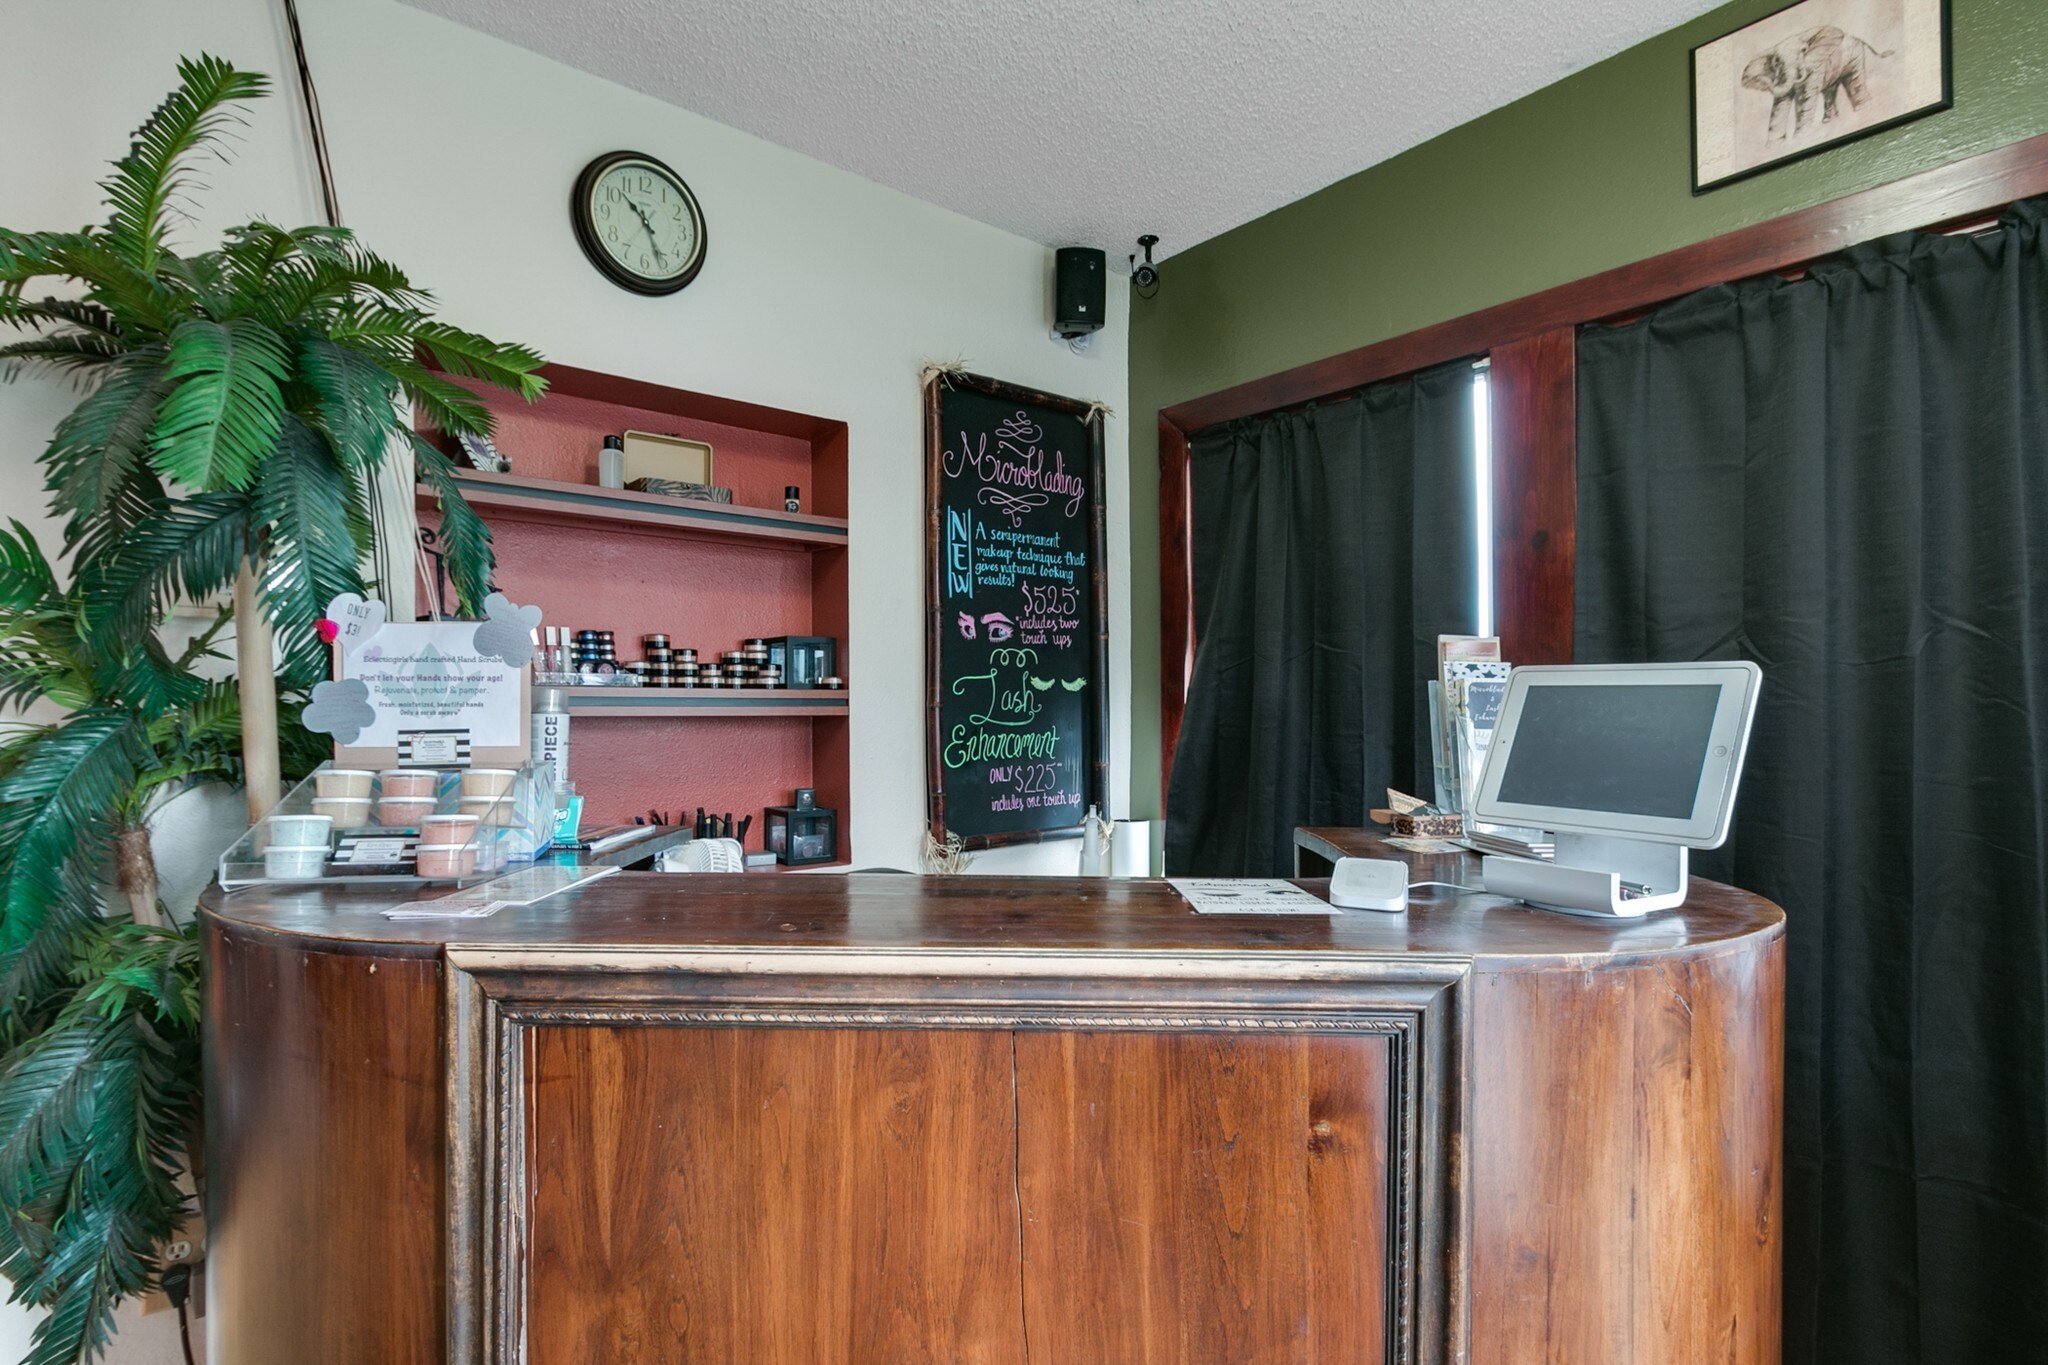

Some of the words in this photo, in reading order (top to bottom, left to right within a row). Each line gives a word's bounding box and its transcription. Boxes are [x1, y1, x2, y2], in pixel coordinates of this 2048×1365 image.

[622, 176, 631, 193] 11
[639, 176, 652, 194] 12
[607, 185, 621, 204] 10
[662, 188, 666, 203] 1
[600, 204, 610, 220] 9
[672, 203, 681, 222] 2
[608, 225, 618, 242] 8
[678, 224, 687, 241] 3
[622, 242, 631, 260] 7
[671, 242, 680, 258] 4
[640, 253, 650, 270] 6
[942, 430, 1085, 518] Microblading
[975, 521, 987, 540] A
[990, 526, 1061, 548] semipermanent
[950, 510, 971, 594] NEW
[976, 543, 1014, 564] makeup
[1016, 546, 1063, 568] technique
[1063, 551, 1086, 567] that
[974, 558, 999, 576] gives
[1000, 562, 1037, 577] natural
[1039, 564, 1074, 584] looking
[977, 572, 1016, 588] results!
[346, 602, 372, 620] ONLY
[344, 621, 361, 638] $3!
[1059, 617, 1080, 630] two
[1020, 627, 1048, 645] touch
[1052, 635, 1073, 650] ups
[409, 655, 429, 663] hand
[430, 655, 456, 663] crafted
[457, 655, 477, 664] Hand
[360, 673, 381, 682] Don't
[382, 673, 394, 682] let
[395, 675, 415, 684] your
[416, 673, 442, 682] Hands
[443, 674, 464, 682] show
[466, 675, 486, 684] your
[487, 674, 504, 684] age!
[449, 685, 458, 695] &
[459, 686, 491, 696] pamper.
[952, 667, 1042, 727] Lash
[543, 716, 559, 782] PIECE
[943, 723, 1061, 769] Enhancement
[989, 764, 1014, 785] ONLY
[991, 793, 1024, 812] includes
[1026, 796, 1041, 808] one
[1042, 789, 1067, 807] touch
[1068, 792, 1081, 809] up
